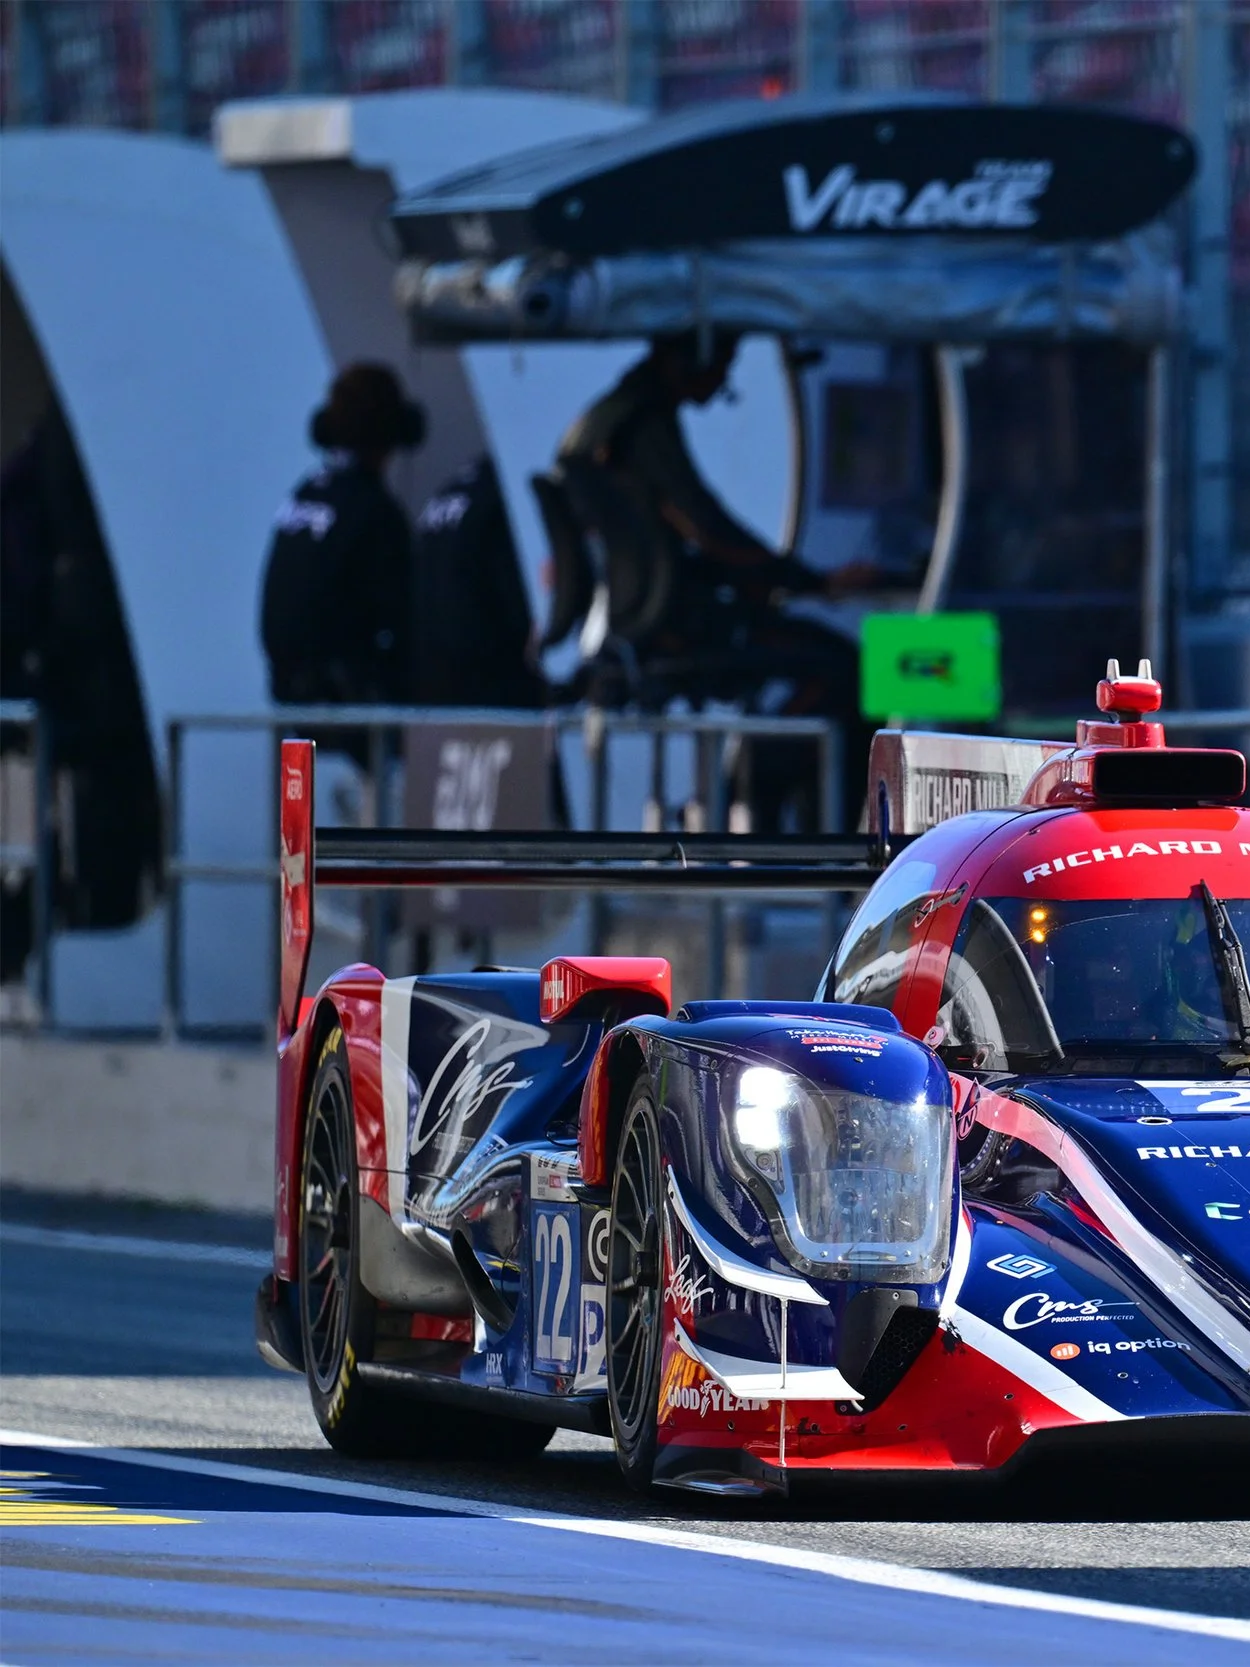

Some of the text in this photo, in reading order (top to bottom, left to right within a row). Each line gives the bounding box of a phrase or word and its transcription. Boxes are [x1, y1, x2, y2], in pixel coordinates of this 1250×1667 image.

[783, 163, 1047, 230] VIRAGE
[1022, 841, 1222, 884] RICHARD
[535, 1213, 572, 1361] 22
[579, 1300, 606, 1375] P
[1051, 1314, 1135, 1323] PRODUCTION PERFECTED
[1087, 1337, 1191, 1354] iq option
